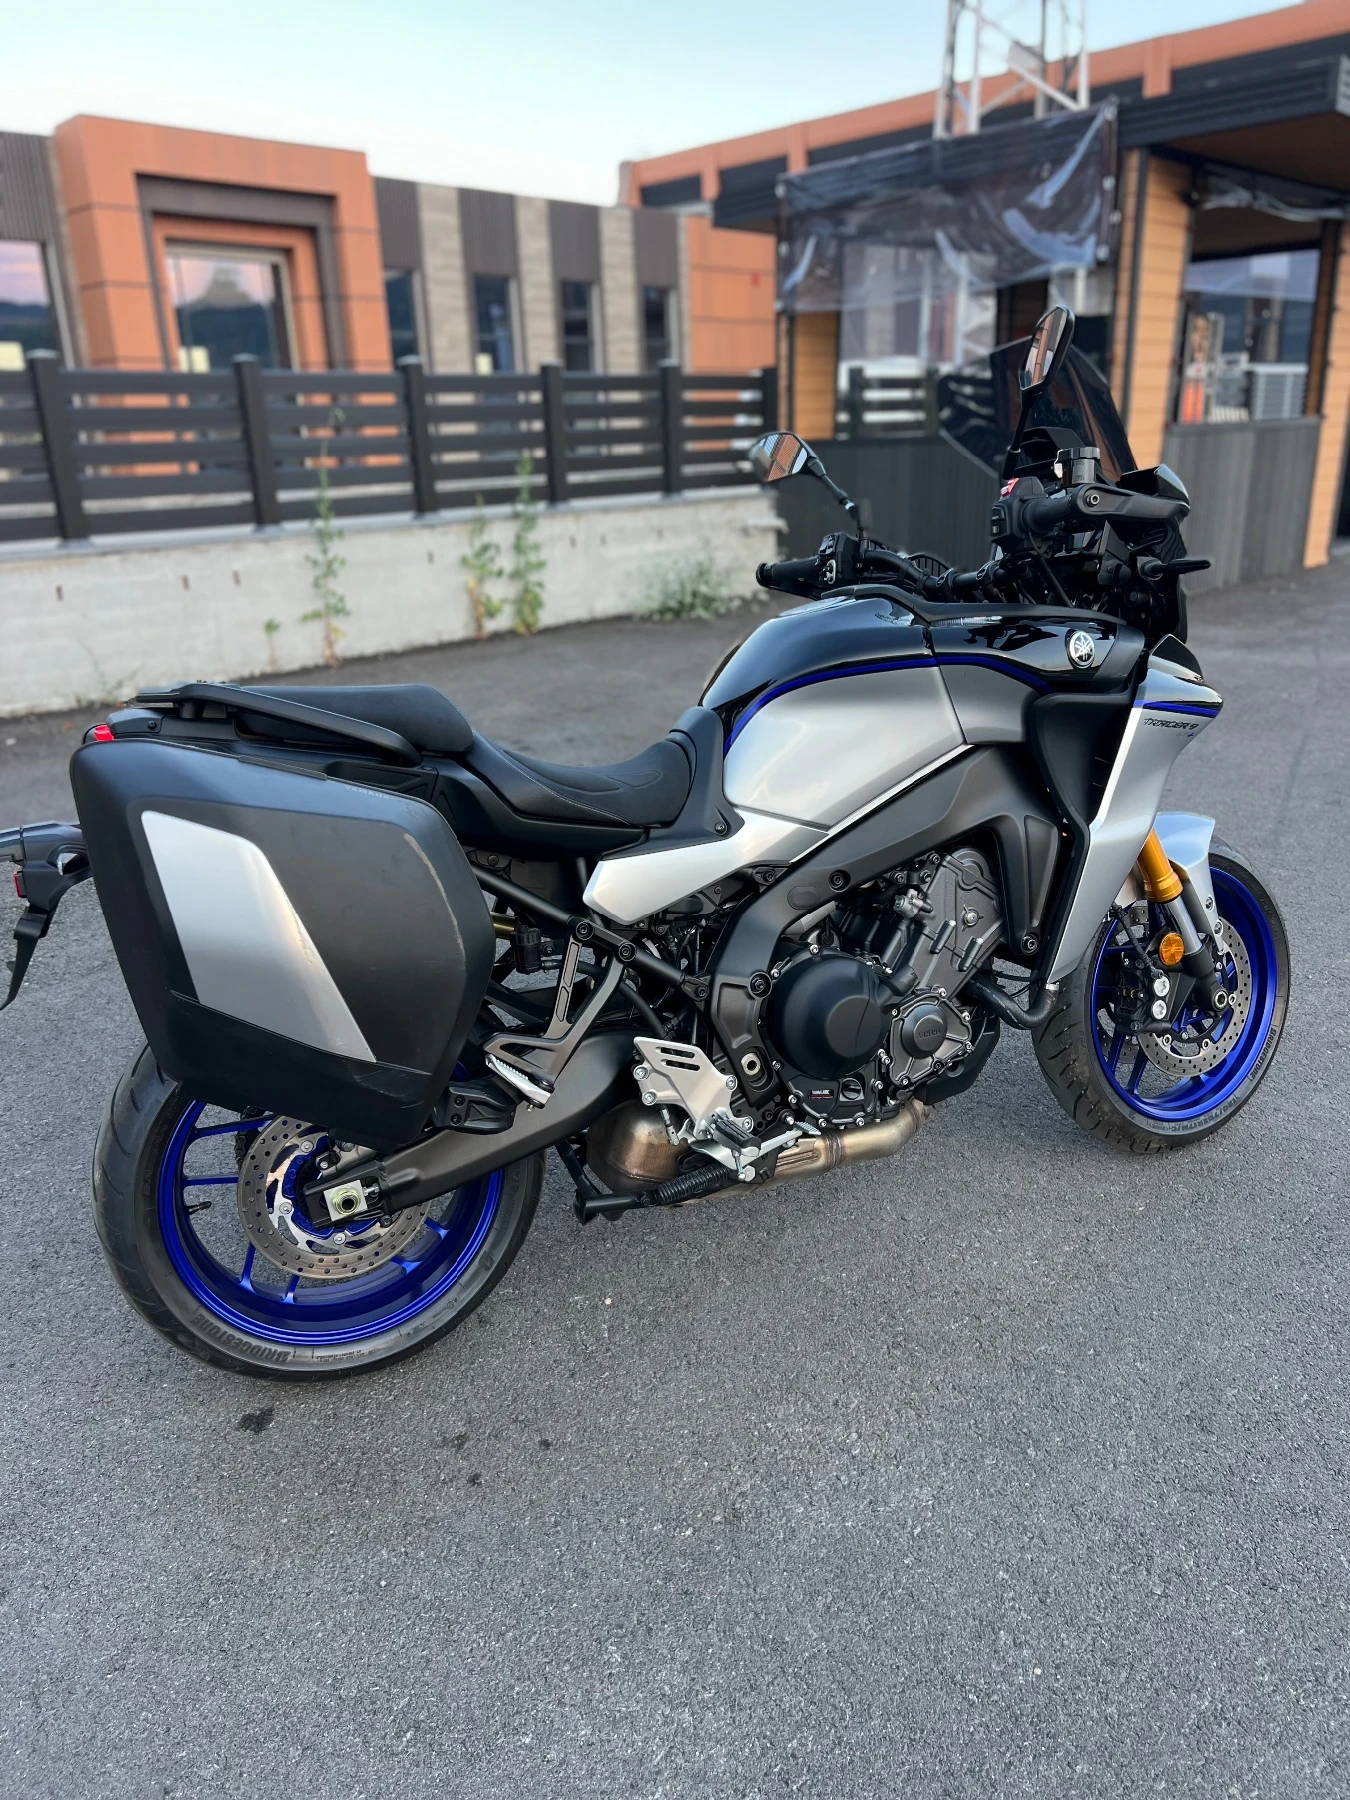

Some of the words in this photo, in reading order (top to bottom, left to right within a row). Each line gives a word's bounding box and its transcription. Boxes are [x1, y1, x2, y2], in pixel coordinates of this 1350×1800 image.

[1144, 717, 1190, 729] TRACER
[344, 784, 389, 799] YAMAHA
[1250, 1027, 1277, 1079] BRIDGESTONE
[190, 1313, 292, 1364] BRIDGESTONE
